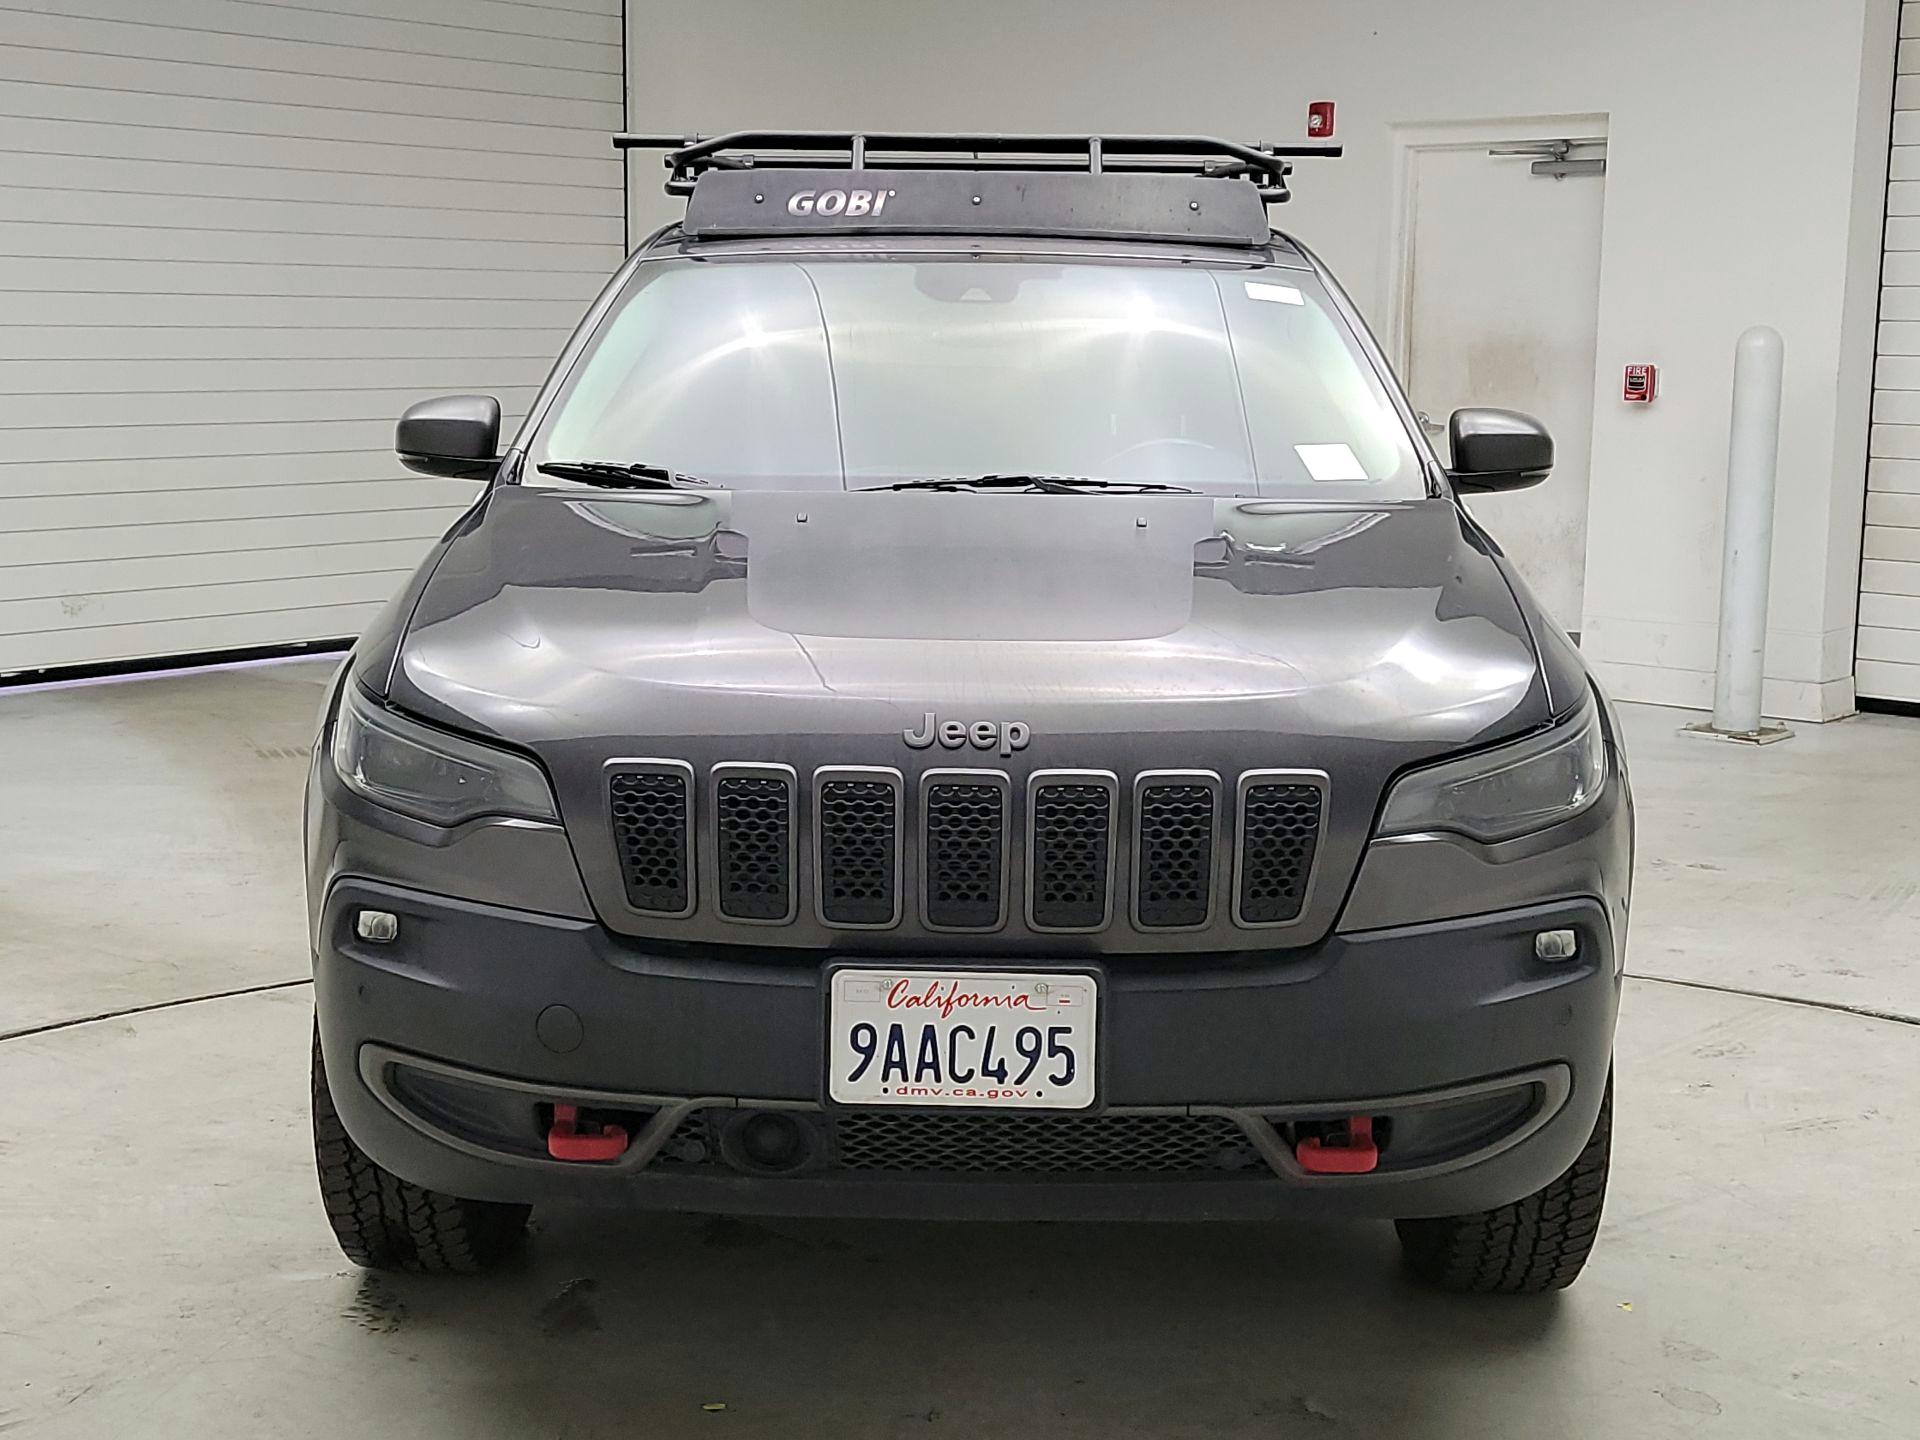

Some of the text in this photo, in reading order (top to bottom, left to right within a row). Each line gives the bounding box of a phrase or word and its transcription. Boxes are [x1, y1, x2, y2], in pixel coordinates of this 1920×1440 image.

[787, 190, 888, 217] GOBI
[1627, 366, 1648, 375] FIRE
[903, 712, 1031, 758] Jeep
[887, 979, 1047, 1019] California
[847, 1022, 1076, 1087] 9AAC495
[896, 1086, 1028, 1099] dmv.ca.gov
